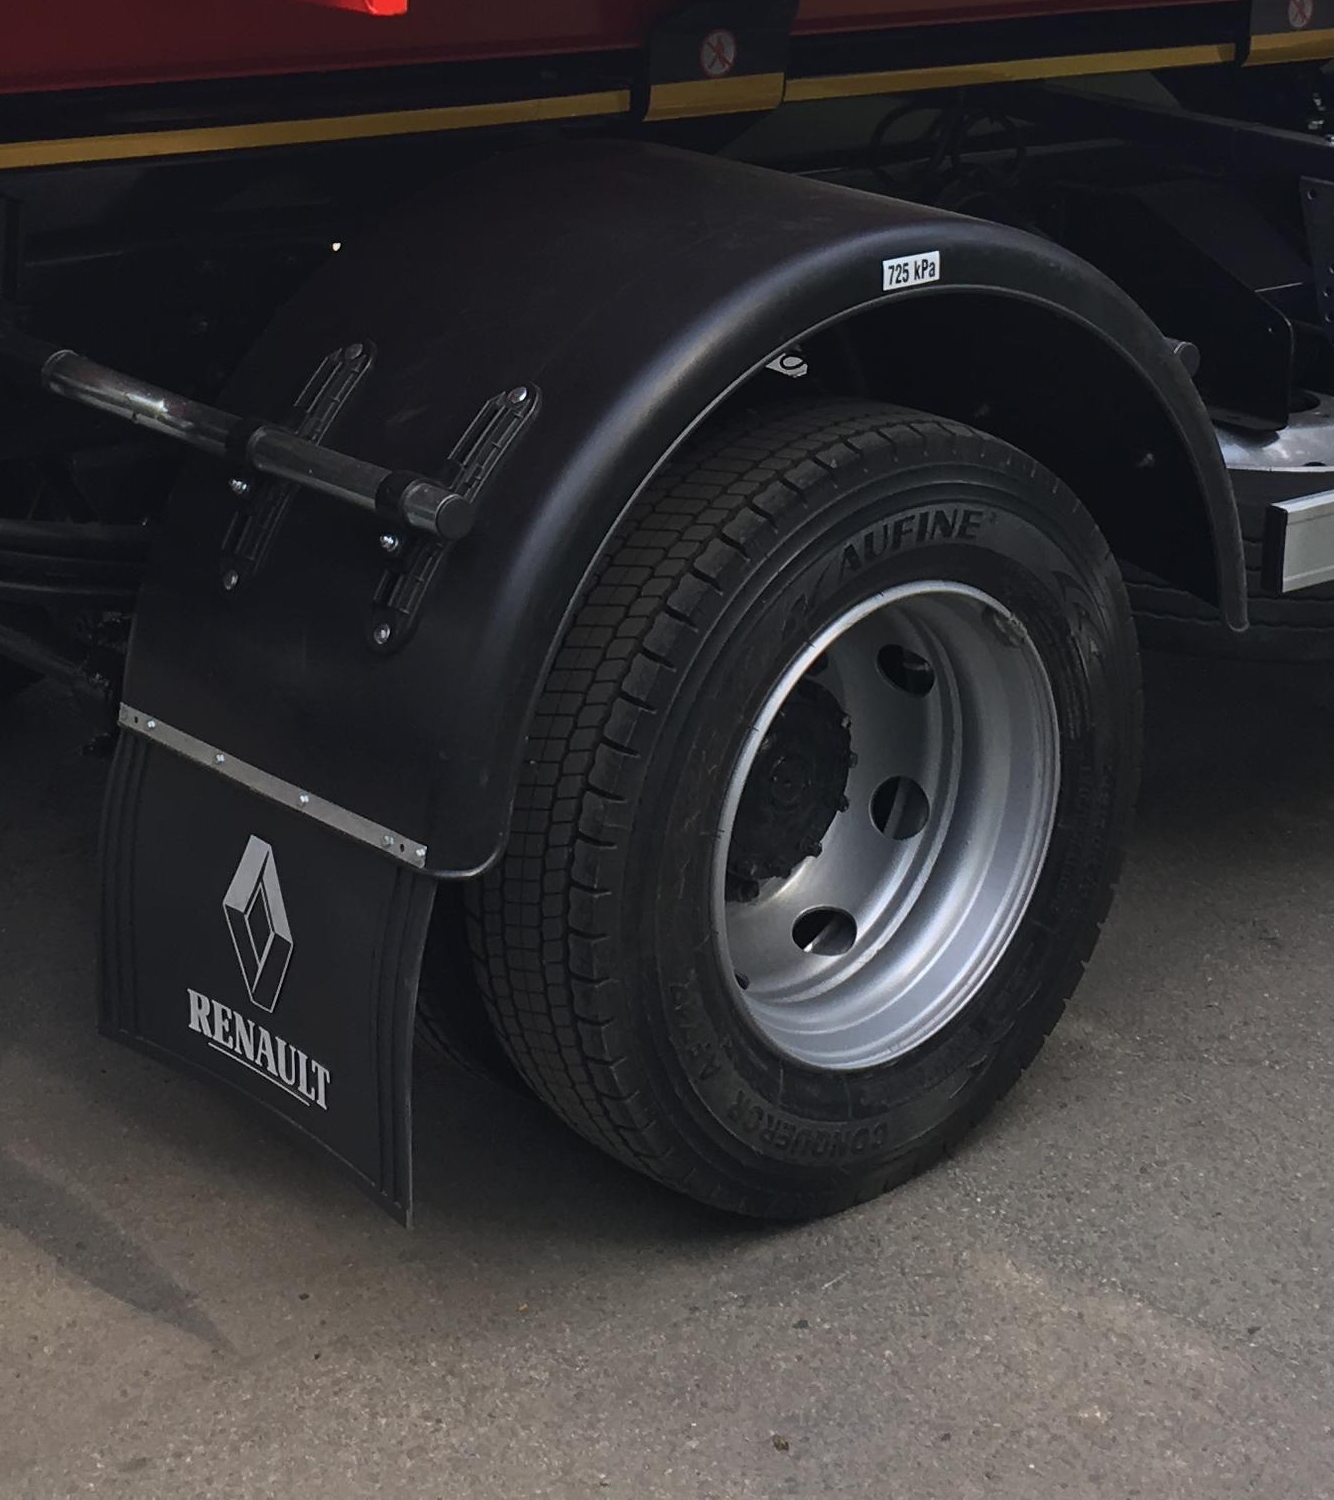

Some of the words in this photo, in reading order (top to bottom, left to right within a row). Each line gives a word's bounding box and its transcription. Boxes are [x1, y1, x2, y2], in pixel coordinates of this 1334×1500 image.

[888, 263, 910, 285] 725
[914, 259, 936, 280] kPa
[838, 509, 984, 581] AUFINE
[187, 988, 331, 1110] RENAULT
